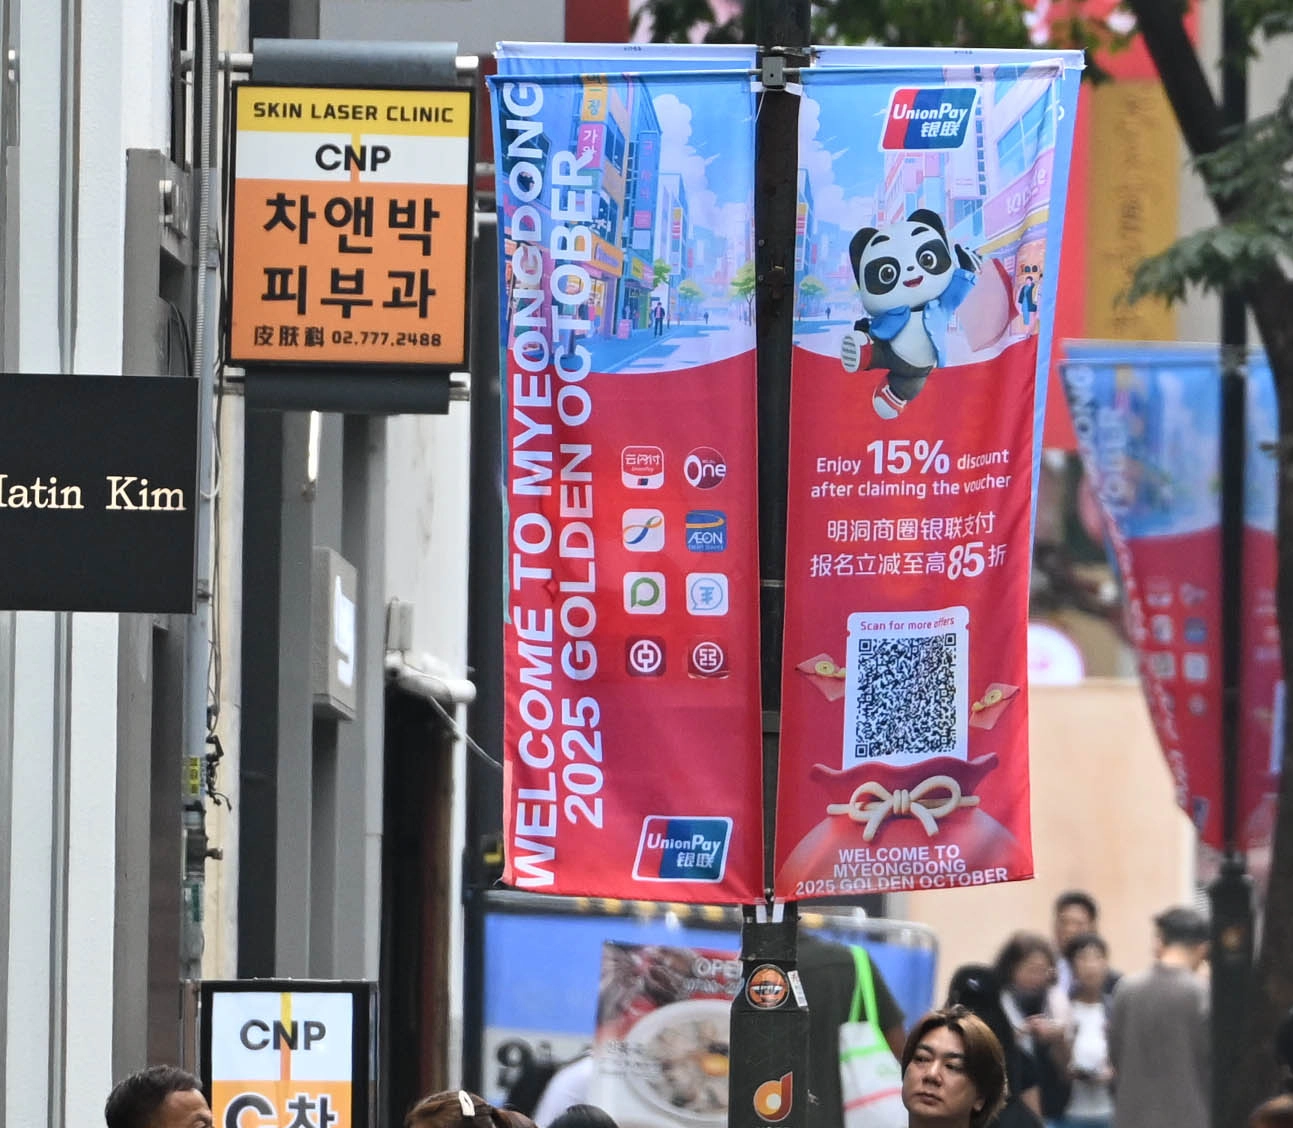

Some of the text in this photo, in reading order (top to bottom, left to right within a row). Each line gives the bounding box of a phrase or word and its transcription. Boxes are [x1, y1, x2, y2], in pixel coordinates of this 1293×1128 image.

[253, 102, 454, 123] SKIN LASER CLINIC
[892, 103, 968, 124] UnionPay
[920, 121, 960, 137] 银联
[315, 145, 391, 172] CNP
[263, 193, 440, 256] 차앤박
[261, 266, 436, 318] 피부과
[332, 331, 442, 347] 02.777.2488
[684, 454, 727, 488] One
[816, 440, 1009, 475] Enjoy 15% discount
[106, 476, 187, 511] Kim
[503, 81, 558, 887] WELCOME TO MYEONGDONG
[550, 151, 604, 830] 2025 GOLDEN OCTOBER
[811, 475, 1011, 499] after claiming the voucher
[827, 511, 995, 541] 明洞商圈银联支付
[811, 541, 1007, 580] 报名立减至高85折
[860, 616, 954, 631] Scan for more offers
[646, 833, 720, 854] UnionPay
[838, 846, 960, 861] WELCOME TO
[676, 851, 714, 869] 银联
[832, 858, 966, 875] MYEONGDONG
[796, 867, 1007, 895] 2025 GOLDEN OCTOBER
[239, 1018, 327, 1051] CNP
